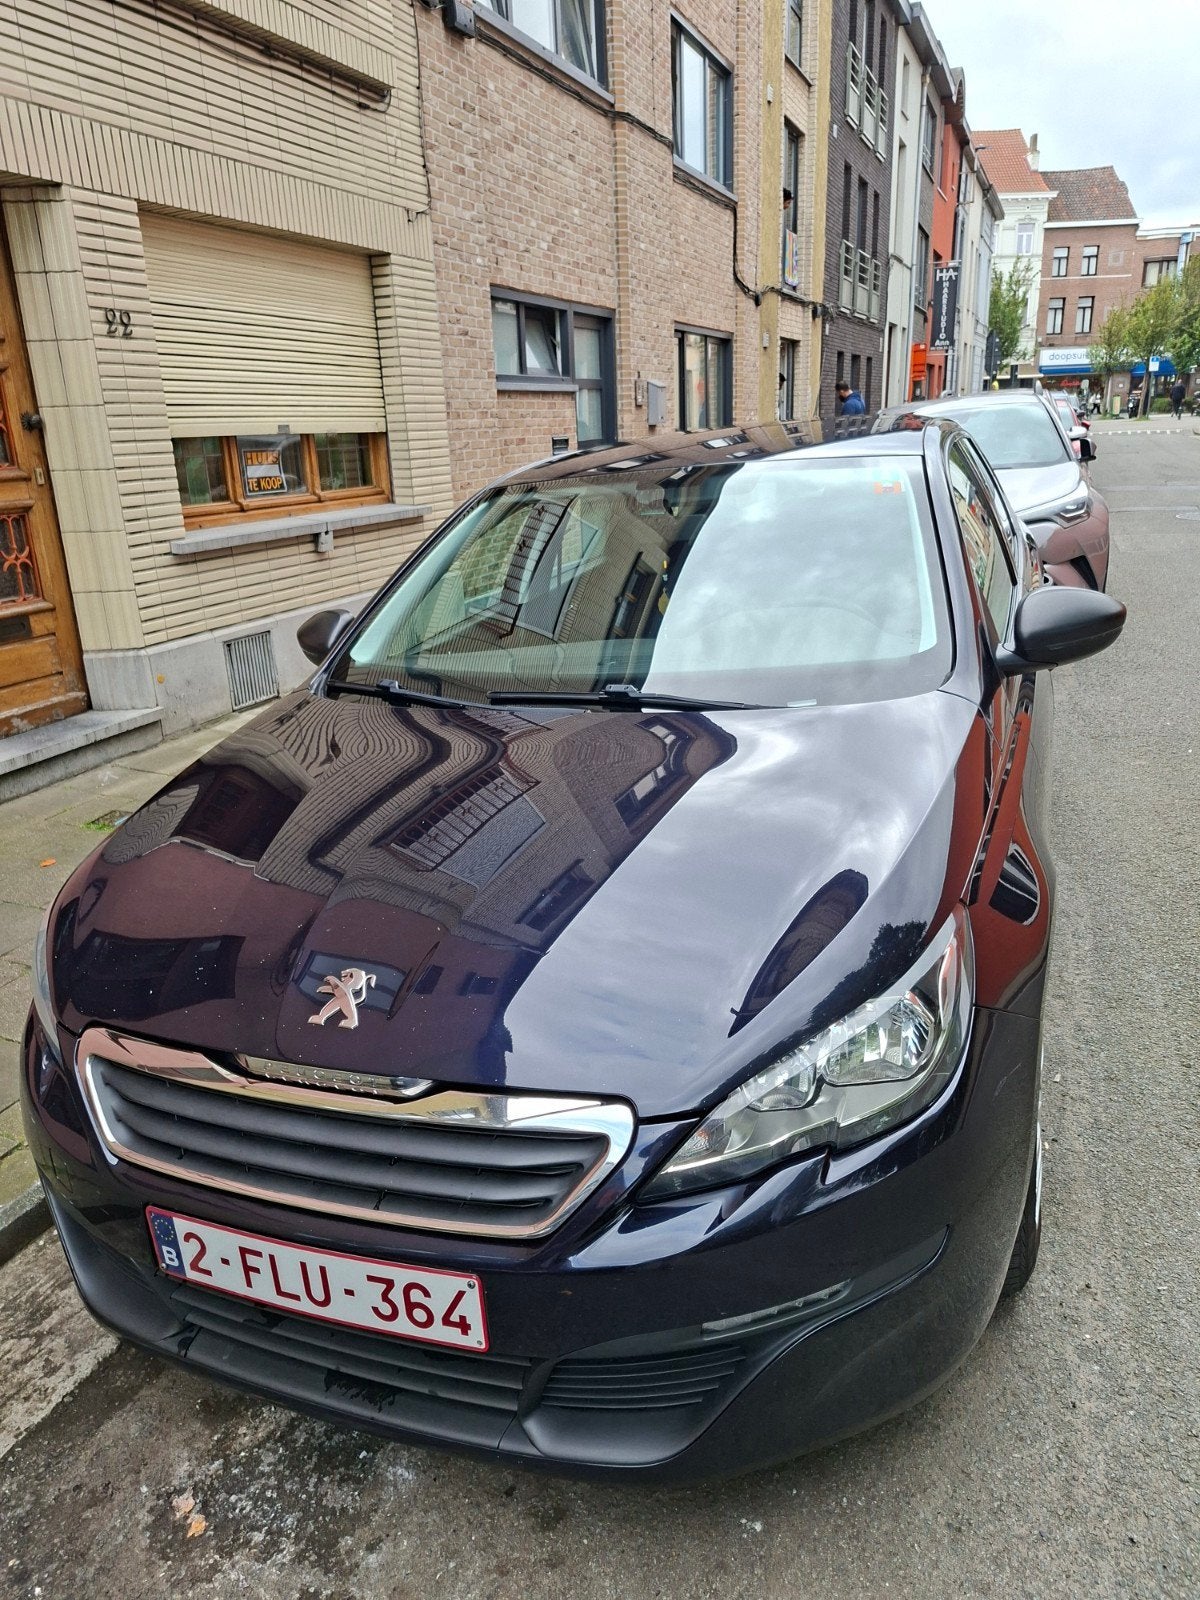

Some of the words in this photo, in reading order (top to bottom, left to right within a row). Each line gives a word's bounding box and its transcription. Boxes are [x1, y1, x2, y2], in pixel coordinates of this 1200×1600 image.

[105, 308, 133, 337] 22
[939, 281, 950, 339] HAARSTUDIO
[246, 451, 279, 465] HUIS
[248, 478, 259, 491] TE
[260, 477, 283, 490] KOOP
[161, 1245, 179, 1267] B
[183, 1231, 472, 1337] 2-FLU-364
